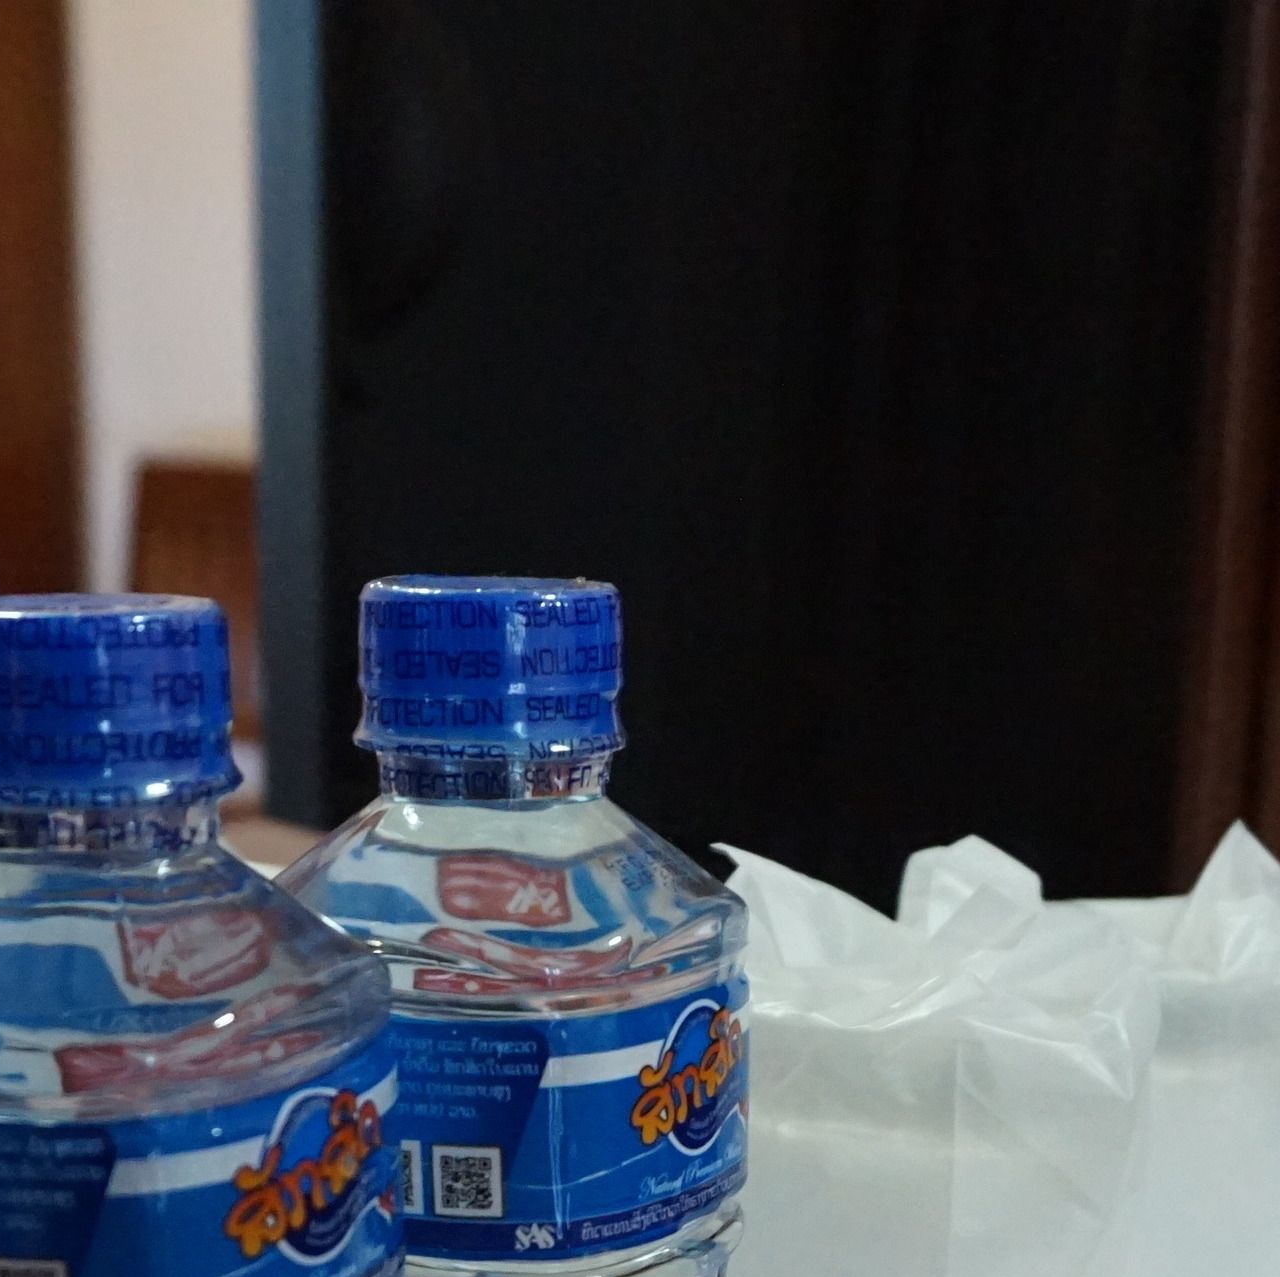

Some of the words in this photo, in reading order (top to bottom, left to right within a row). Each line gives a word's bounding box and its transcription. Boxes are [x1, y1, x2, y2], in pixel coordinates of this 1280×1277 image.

[520, 597, 601, 628] SEALED
[395, 649, 501, 681] SEALED
[152, 671, 204, 707] FOR
[526, 692, 601, 723] SEALED
[514, 1222, 556, 1251] SAS
